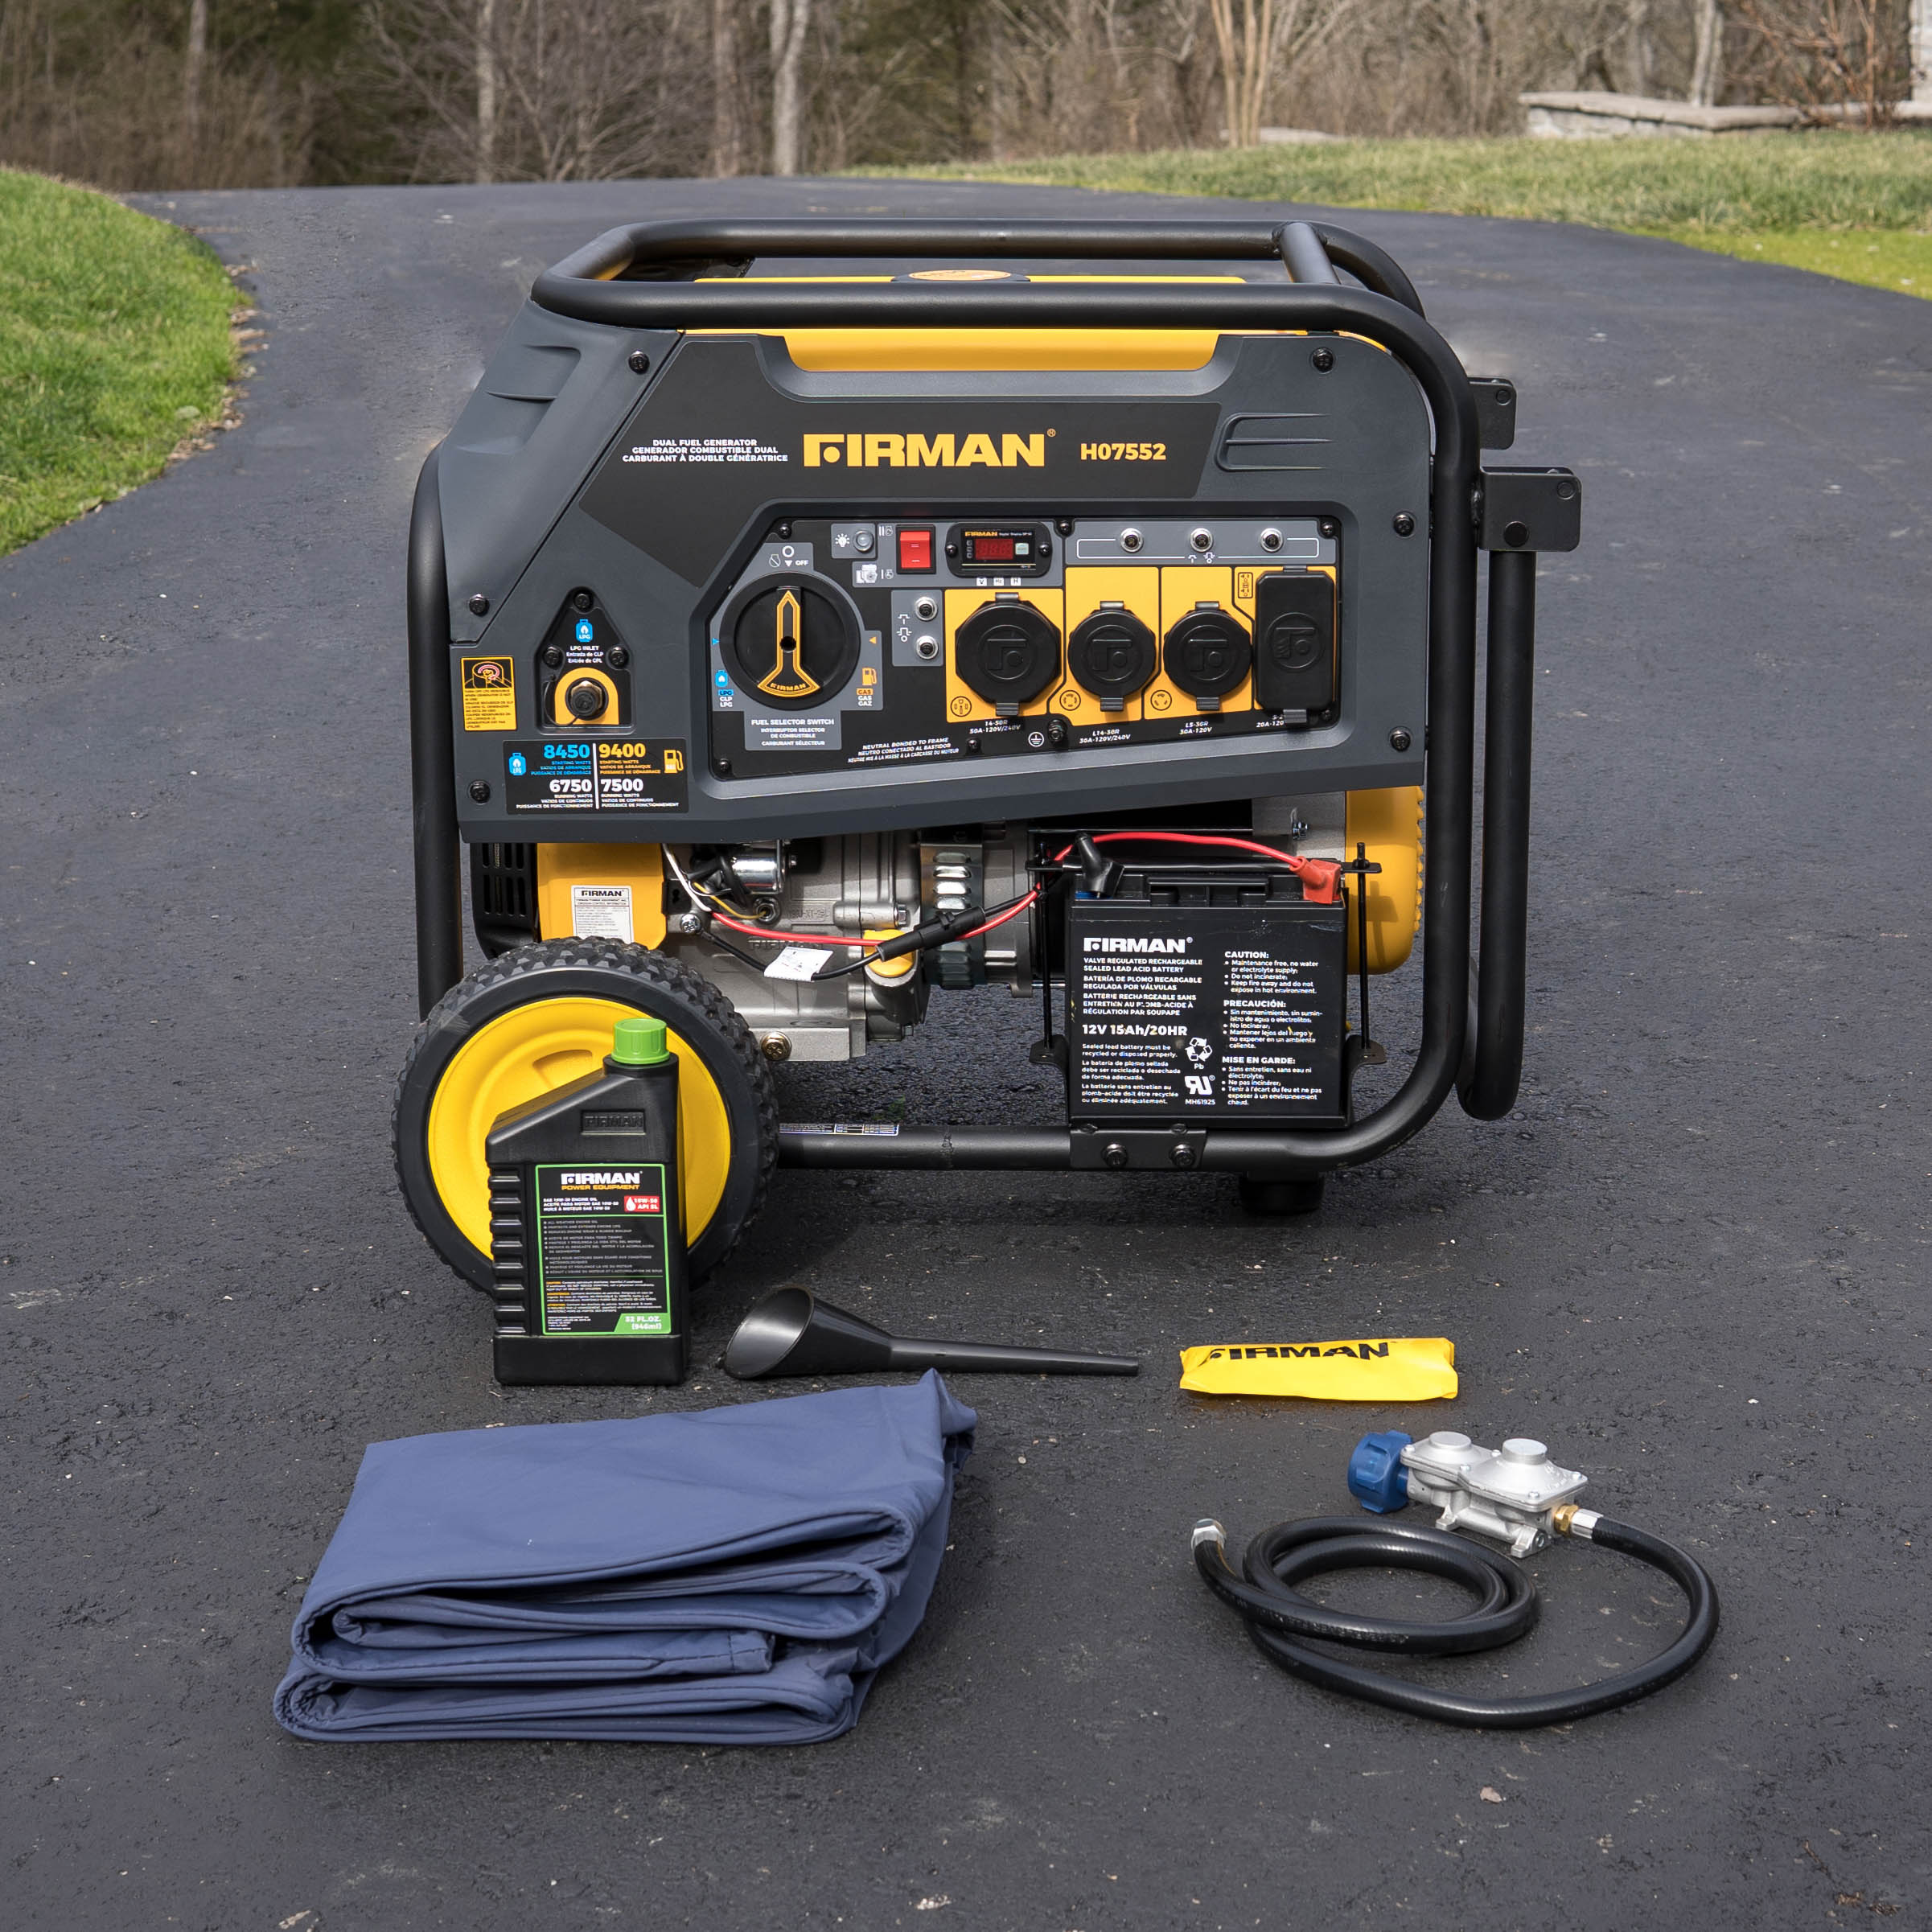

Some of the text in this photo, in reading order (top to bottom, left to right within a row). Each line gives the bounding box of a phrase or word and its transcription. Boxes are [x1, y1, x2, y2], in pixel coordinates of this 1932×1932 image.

[631, 446, 688, 454] GENERADOR
[689, 446, 752, 454] COMBUSTIBLE
[803, 434, 1045, 467] FIRMAN
[1080, 442, 1166, 461] H07552
[622, 454, 677, 462] CARBURANT
[679, 453, 687, 462] À
[726, 453, 788, 462] GÉNÉRATRICE
[770, 683, 807, 692] FIRMAN
[1256, 720, 1285, 728] 20A-120
[544, 744, 590, 758] 8450
[598, 743, 646, 758] 9400
[549, 779, 593, 793] 6750
[600, 778, 643, 792] 7500
[1083, 937, 1186, 953] FIRMAN
[1083, 974, 1114, 982] BATERÍA
[1140, 983, 1177, 991] VÁLVULAS
[1223, 999, 1287, 1008] PRECAUCIÓN:
[1083, 1007, 1128, 1015] RÉGULATION
[1083, 1025, 1187, 1036] 12V 15Ah/20HR
[1246, 1056, 1260, 1064] EN
[561, 1173, 640, 1185] FIRMAN
